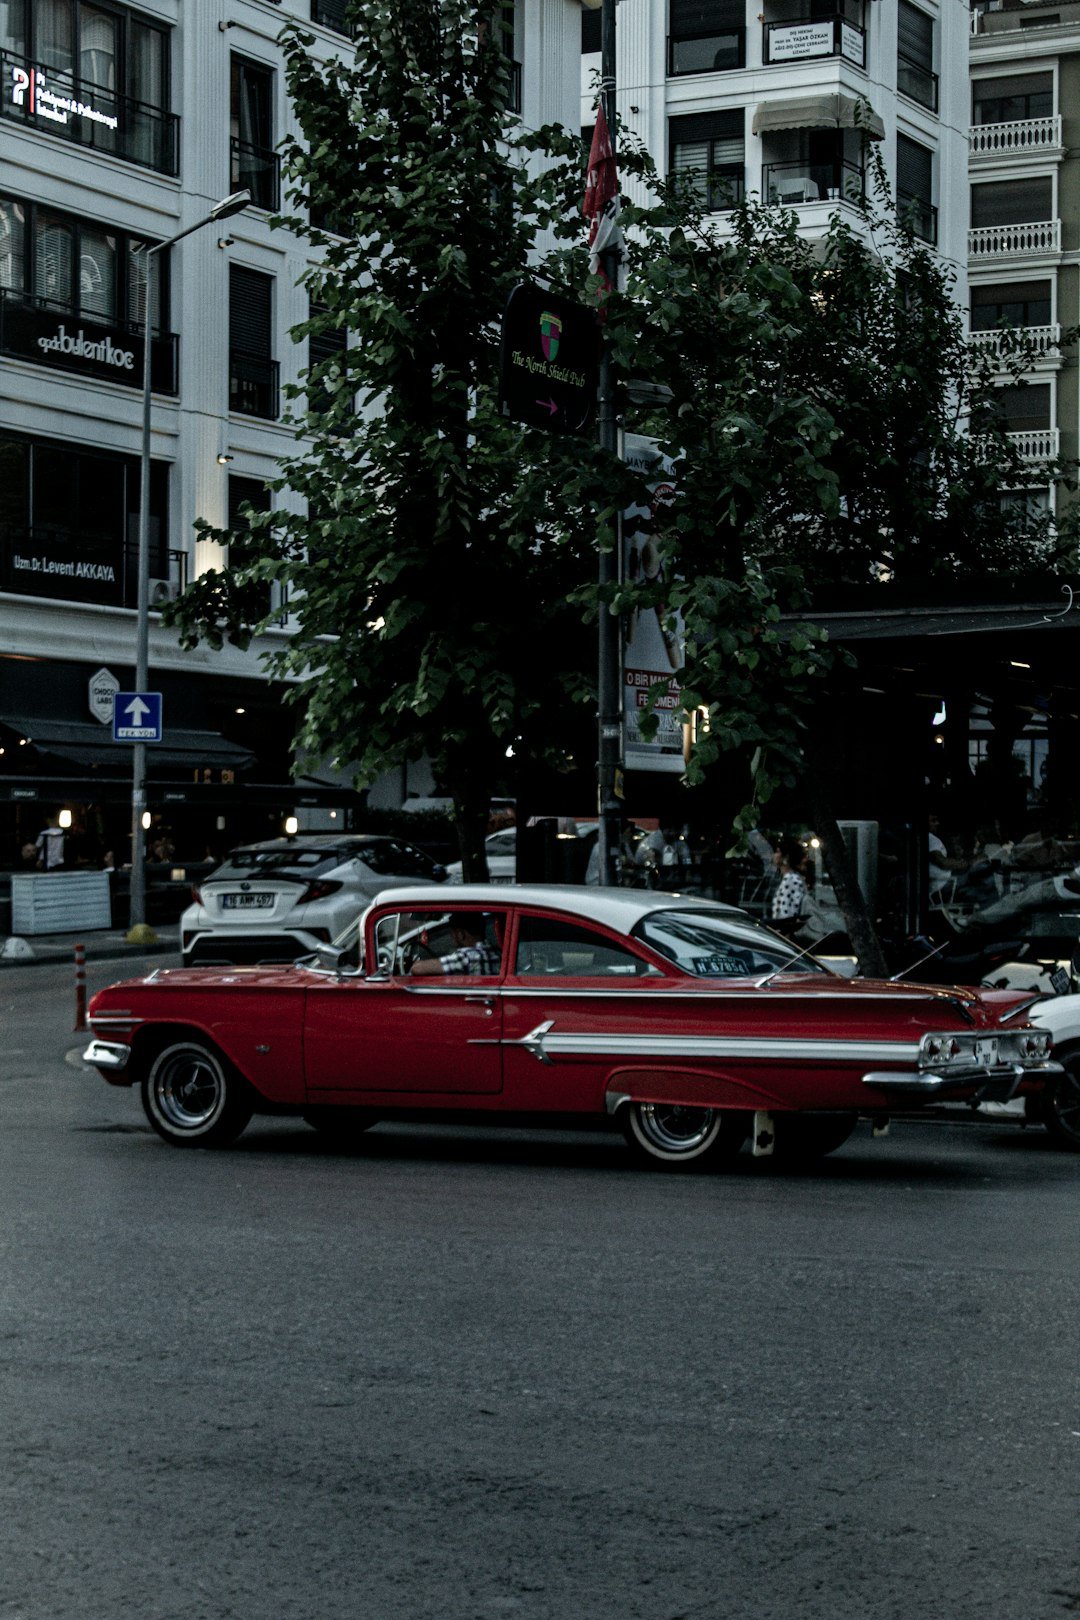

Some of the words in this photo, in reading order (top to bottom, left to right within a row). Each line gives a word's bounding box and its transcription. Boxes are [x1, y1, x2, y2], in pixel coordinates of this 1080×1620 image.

[511, 350, 525, 367] The
[525, 355, 547, 375] North
[547, 364, 569, 383] Shield
[569, 371, 587, 388] Pub
[42, 556, 75, 577] Levent
[75, 561, 115, 582] AKKAYA
[626, 672, 634, 685] O
[634, 671, 649, 687] BİR
